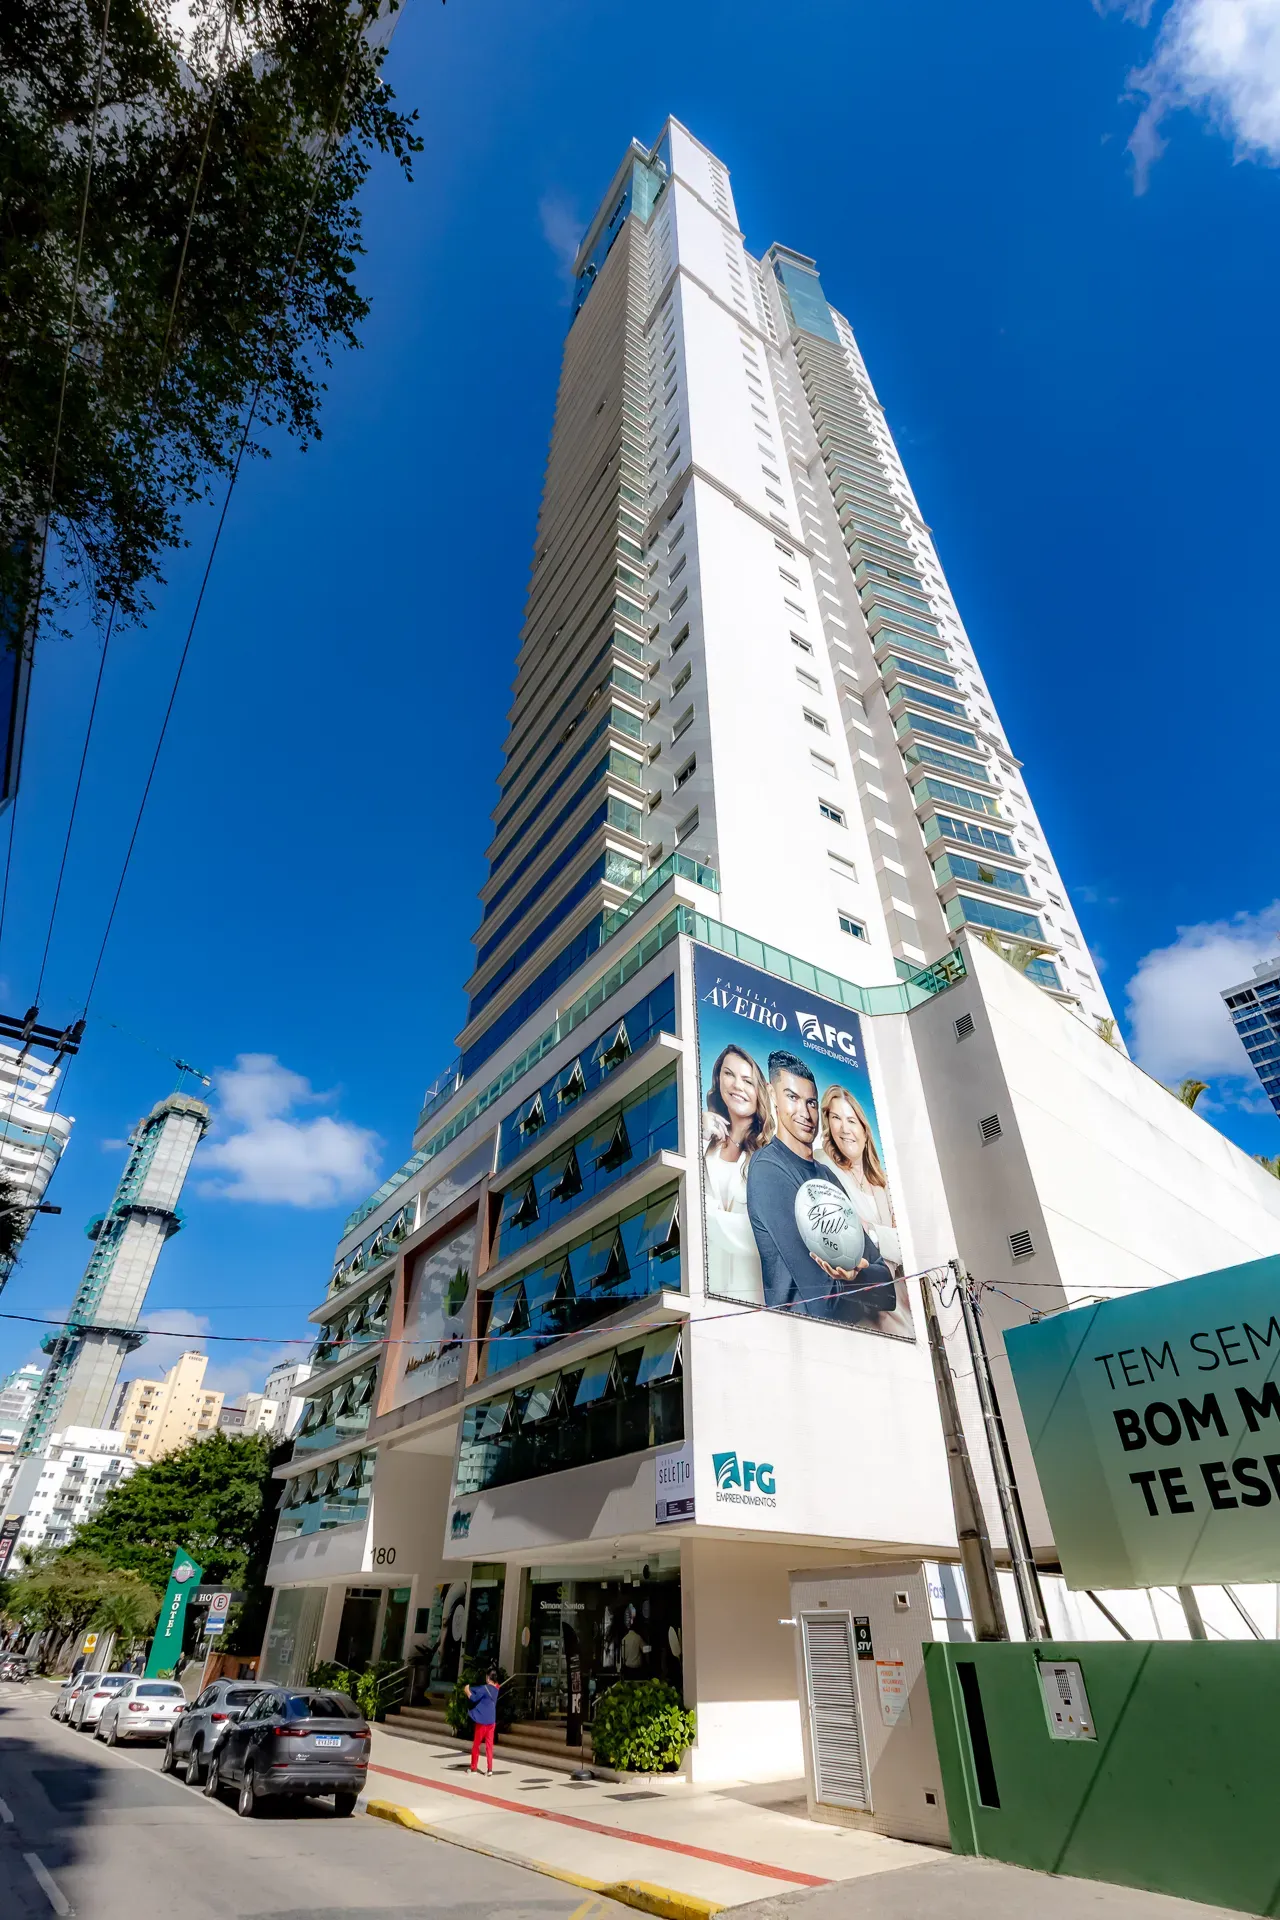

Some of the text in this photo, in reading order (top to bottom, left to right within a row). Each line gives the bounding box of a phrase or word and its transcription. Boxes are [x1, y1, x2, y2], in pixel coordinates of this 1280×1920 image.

[716, 977, 777, 1008] FAMÍLIA
[701, 986, 788, 1032] AVEIRO
[803, 1040, 859, 1068] EMPREENDIMENTOS
[1094, 1341, 1180, 1390] TEM
[1112, 1393, 1229, 1452] BOM
[659, 1461, 690, 1484] SELETTO
[716, 1491, 777, 1508] EMPREENDIMENTOS
[1129, 1467, 1195, 1517] TE
[370, 1547, 396, 1565] 180
[164, 1593, 183, 1637] HOTEL
[216, 1598, 225, 1608] E
[564, 1601, 585, 1610] Santos
[857, 1641, 872, 1651] STV
